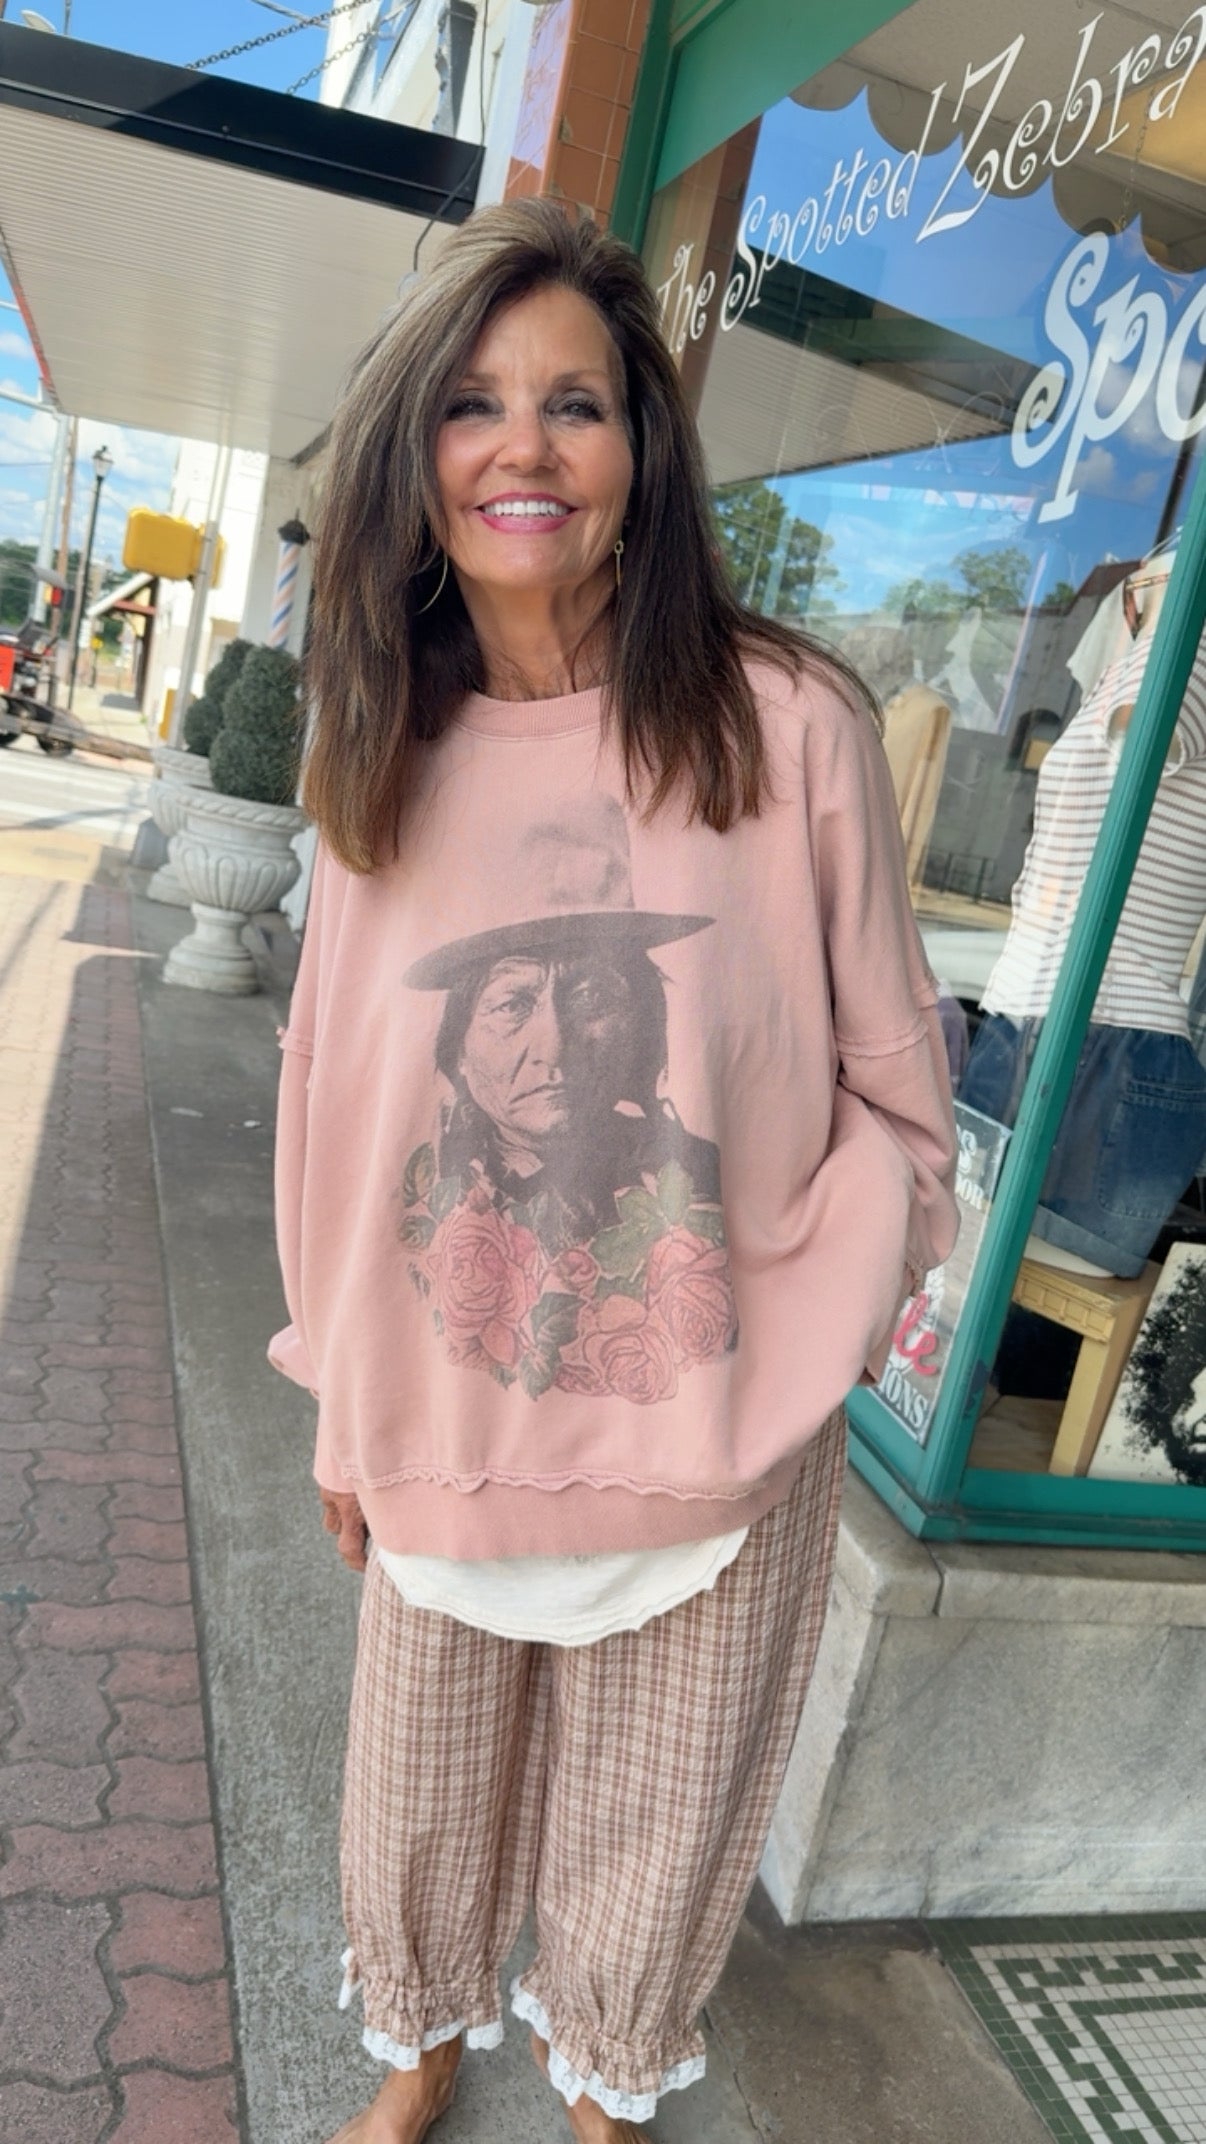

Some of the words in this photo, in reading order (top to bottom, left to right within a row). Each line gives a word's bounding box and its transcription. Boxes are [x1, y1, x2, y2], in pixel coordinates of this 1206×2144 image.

[656, 244, 716, 354] The
[720, 82, 948, 331] Spotted
[916, 5, 1206, 243] Zebra
